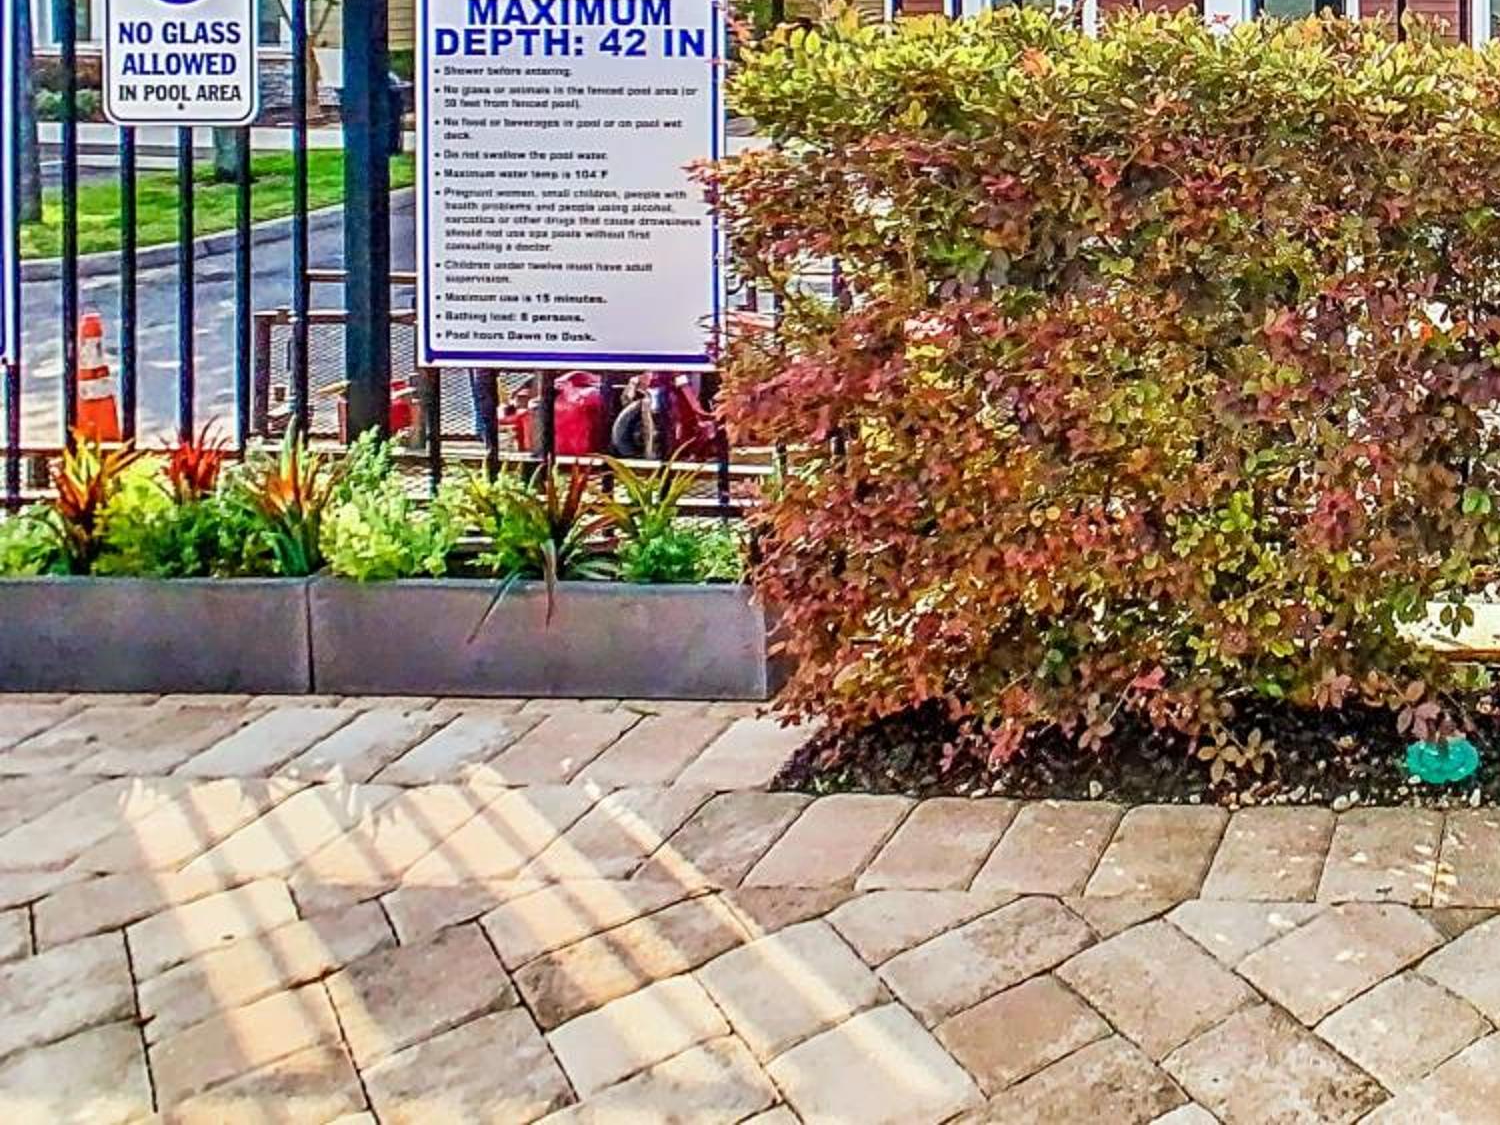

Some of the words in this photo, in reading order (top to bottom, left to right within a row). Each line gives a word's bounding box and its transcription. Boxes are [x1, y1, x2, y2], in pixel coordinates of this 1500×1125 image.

[118, 21, 153, 44] NO
[162, 21, 241, 44] GLASS
[435, 28, 583, 56] DEPTH:
[599, 29, 647, 56] 42
[664, 29, 705, 57] IN
[121, 53, 237, 76] ALLOWED
[118, 84, 137, 101] IN
[143, 84, 191, 101] POOL
[195, 84, 242, 101] AREA
[576, 169, 596, 178] 104
[536, 293, 550, 302] 15
